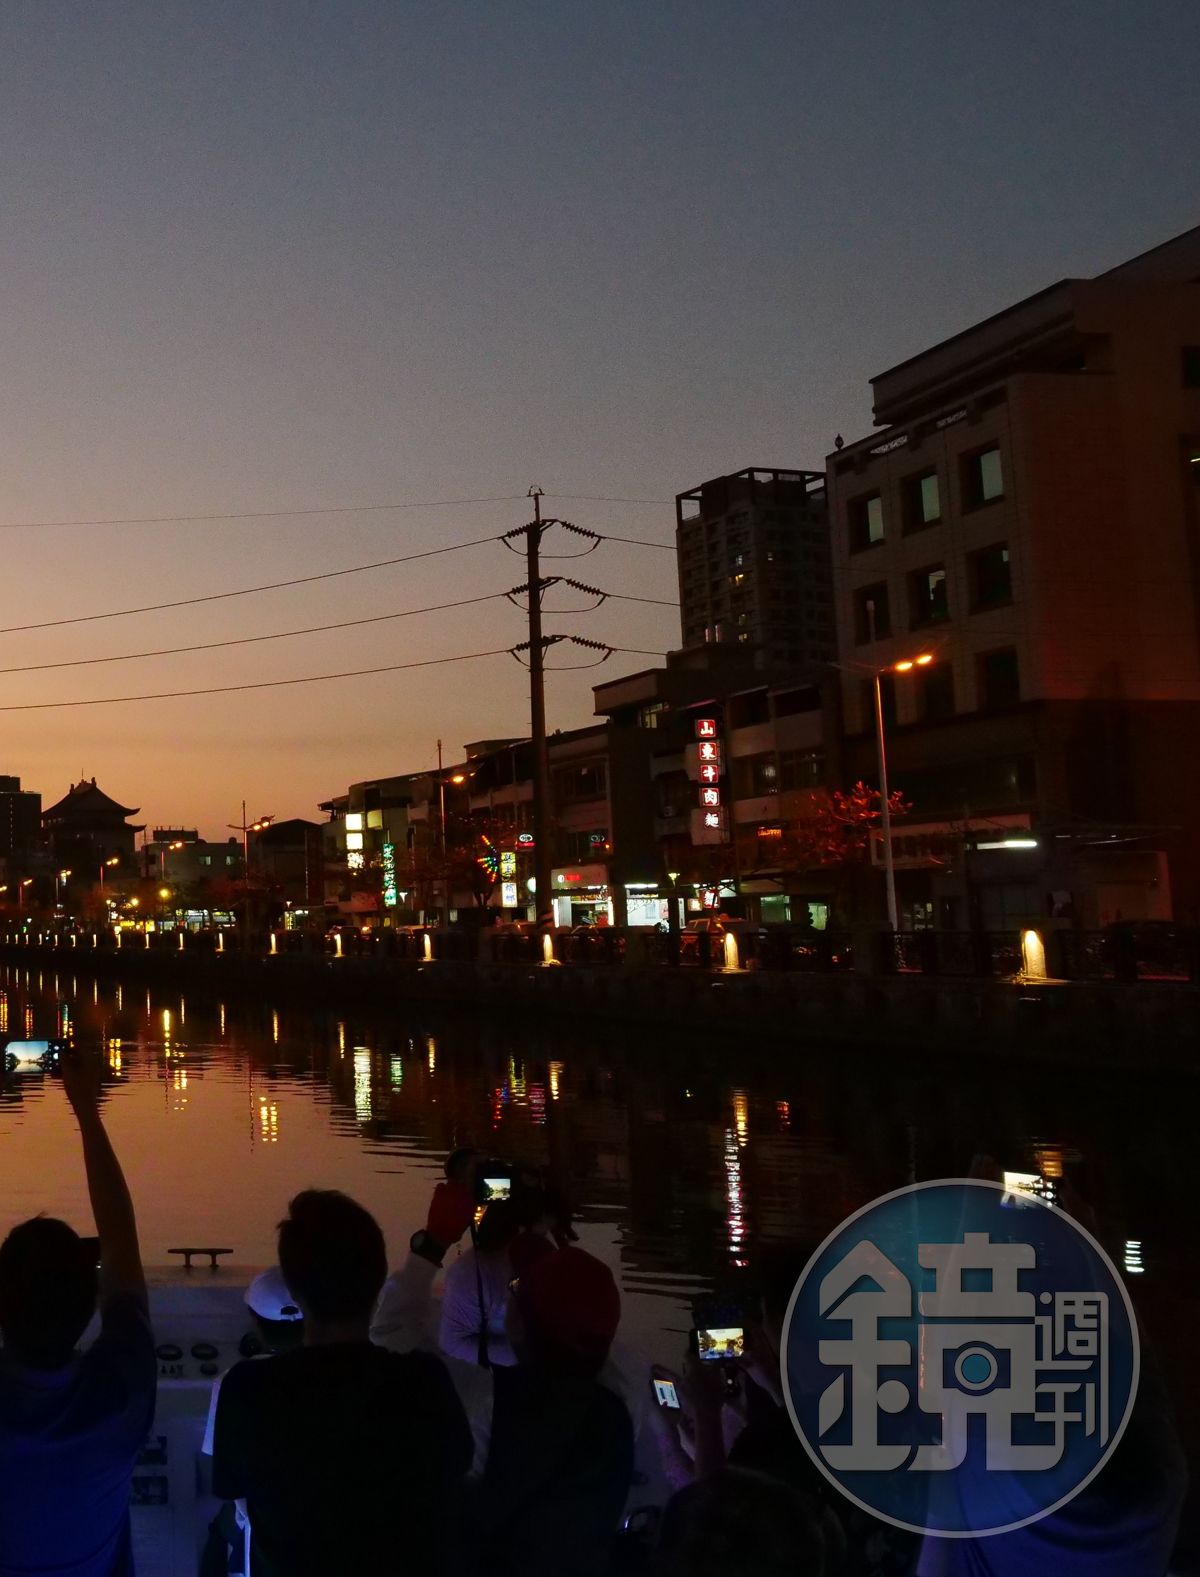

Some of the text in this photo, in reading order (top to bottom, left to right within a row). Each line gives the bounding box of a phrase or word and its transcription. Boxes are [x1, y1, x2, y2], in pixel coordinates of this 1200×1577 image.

[700, 721, 720, 828] 山東牛肉麵
